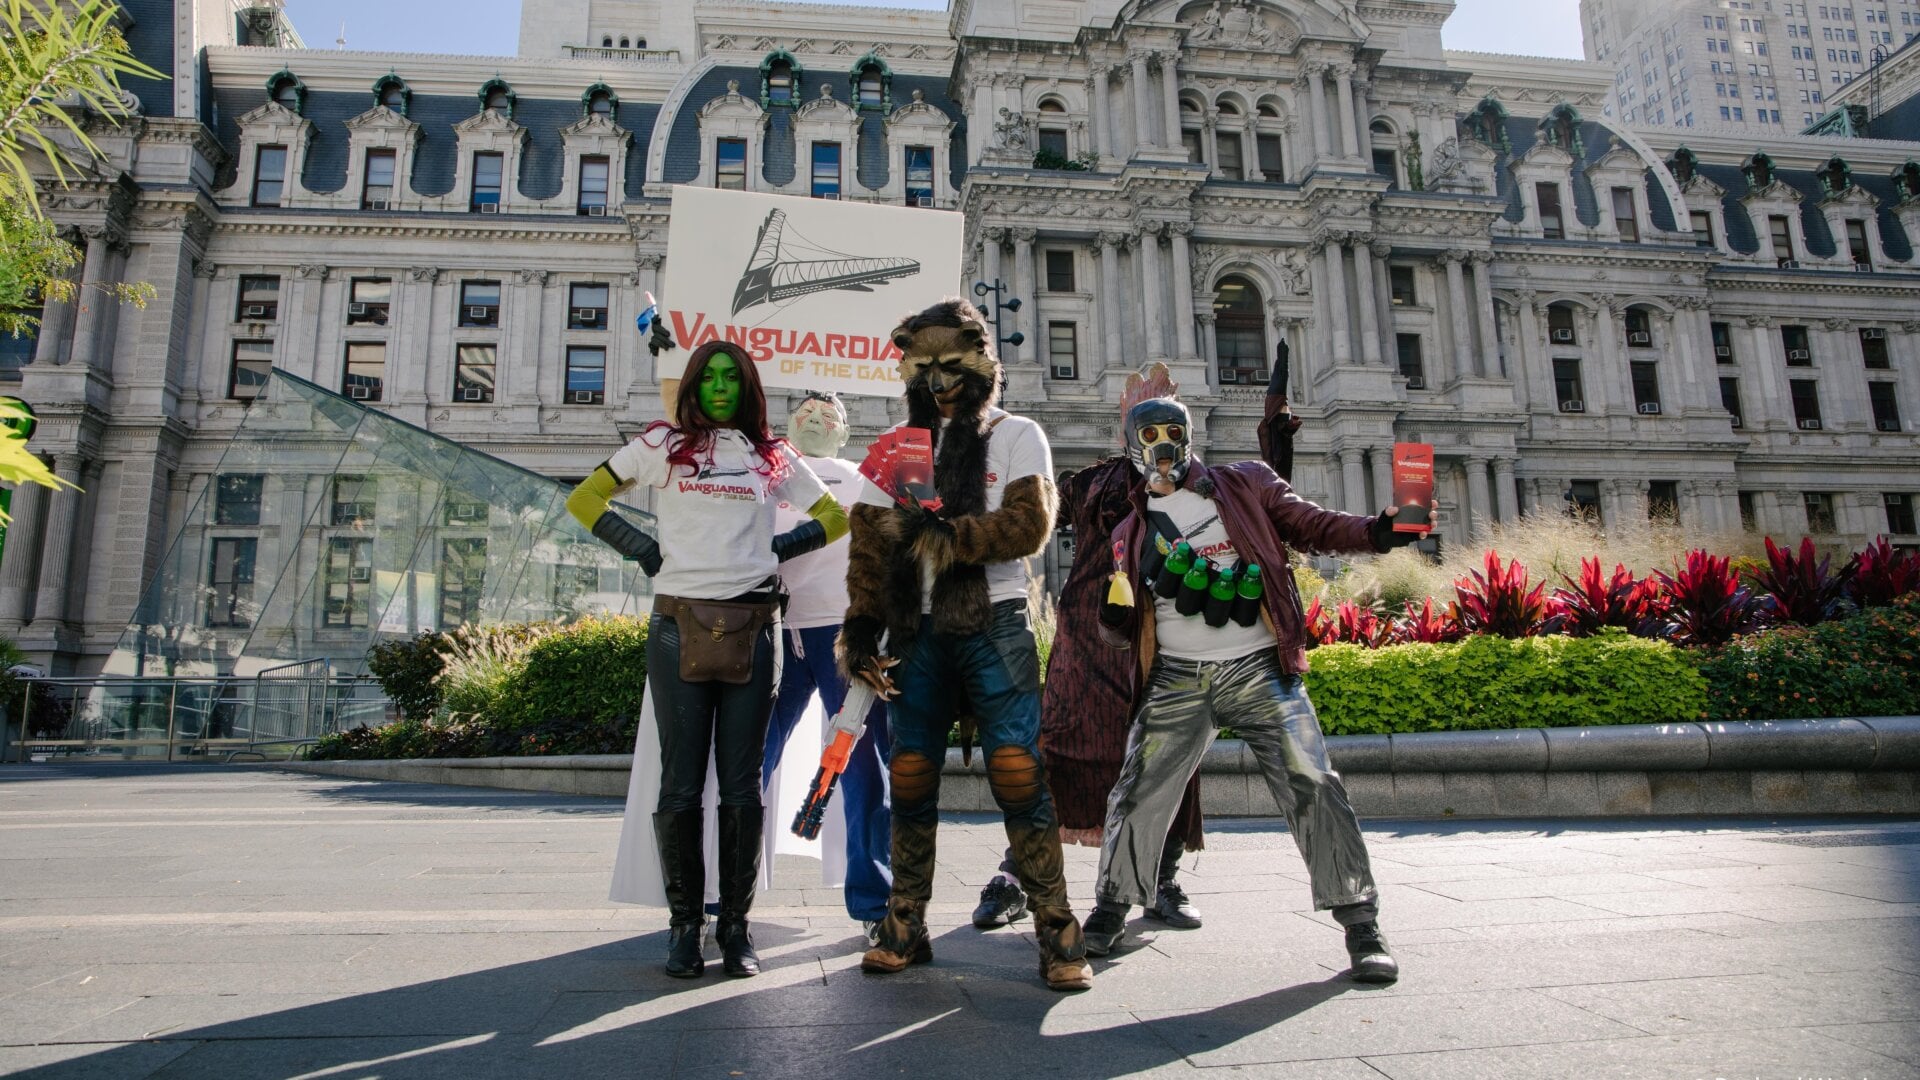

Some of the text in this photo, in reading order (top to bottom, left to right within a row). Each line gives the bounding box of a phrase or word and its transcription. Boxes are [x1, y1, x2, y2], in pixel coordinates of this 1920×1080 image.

[780, 359, 901, 382] OF THE GAL
